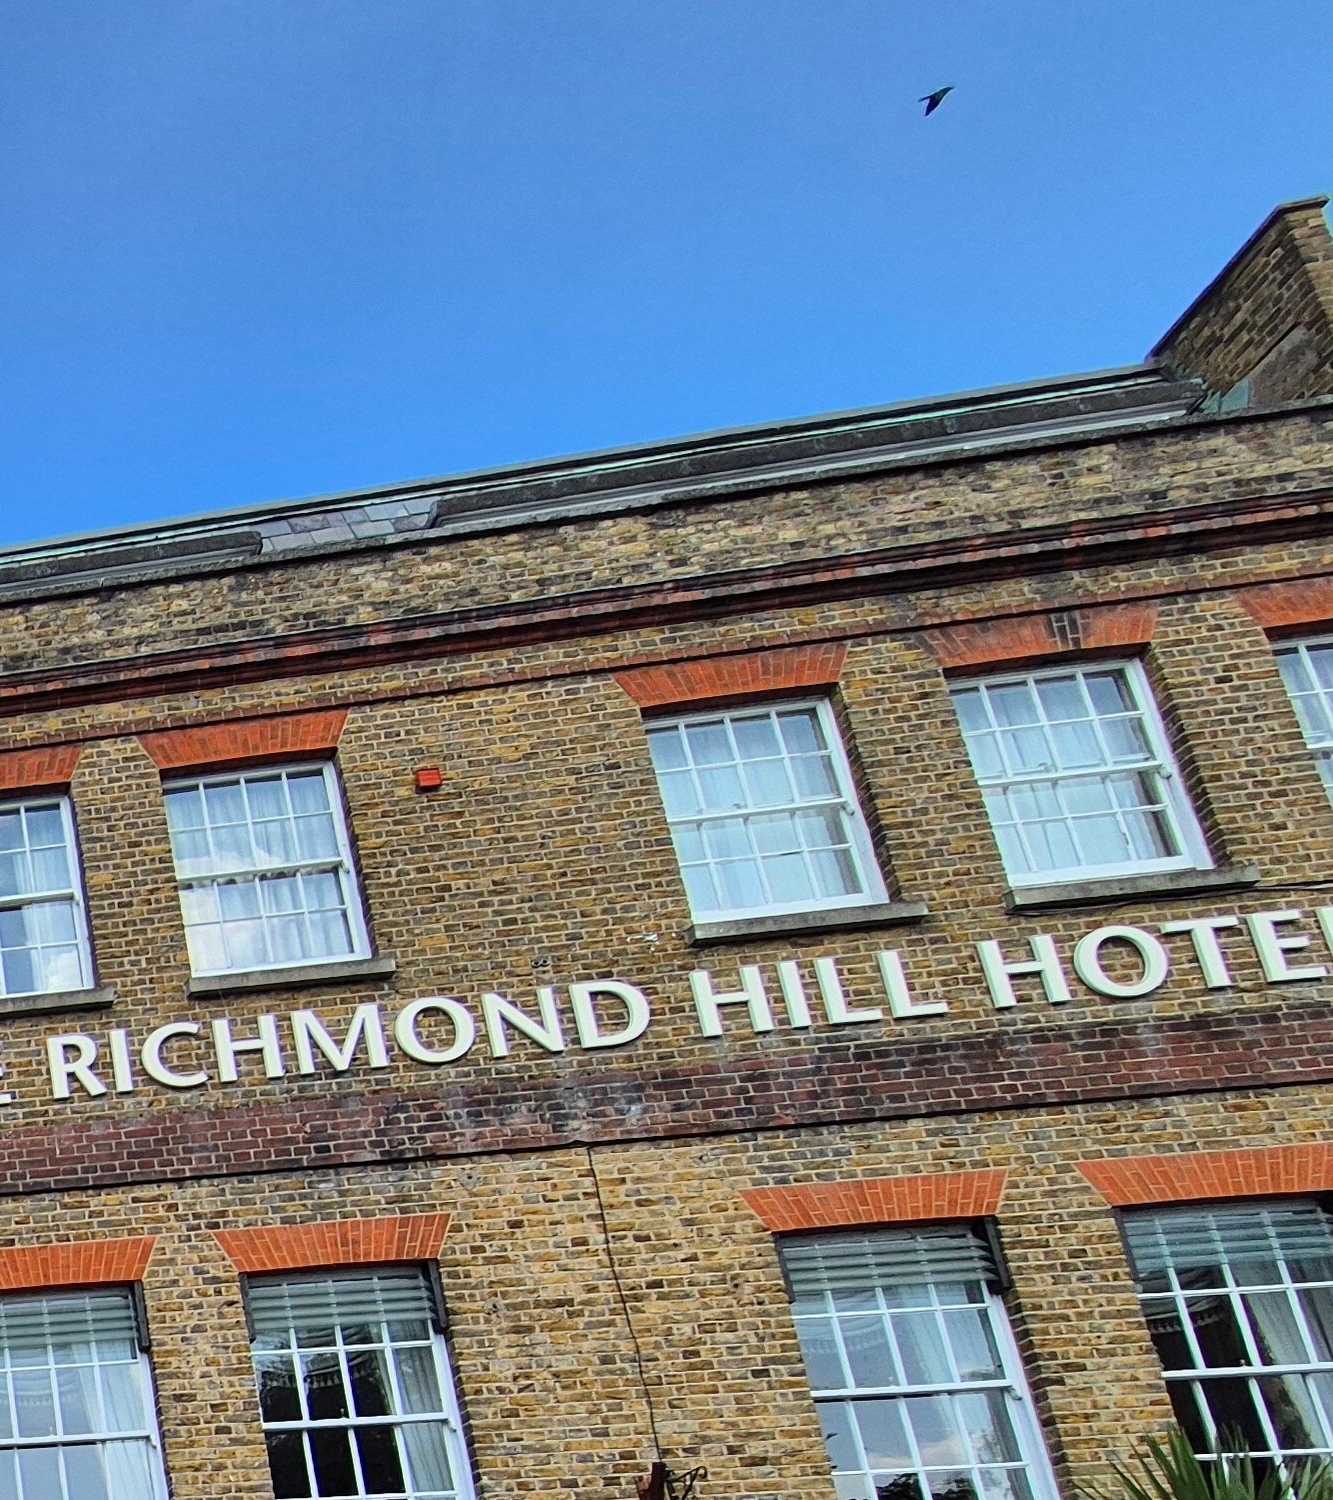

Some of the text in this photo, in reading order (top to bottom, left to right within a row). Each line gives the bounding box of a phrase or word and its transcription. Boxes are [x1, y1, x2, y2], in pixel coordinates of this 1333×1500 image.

[46, 978, 653, 1099] RICHMOND
[688, 948, 950, 1038] HILL
[976, 907, 1333, 1010] HOTE
